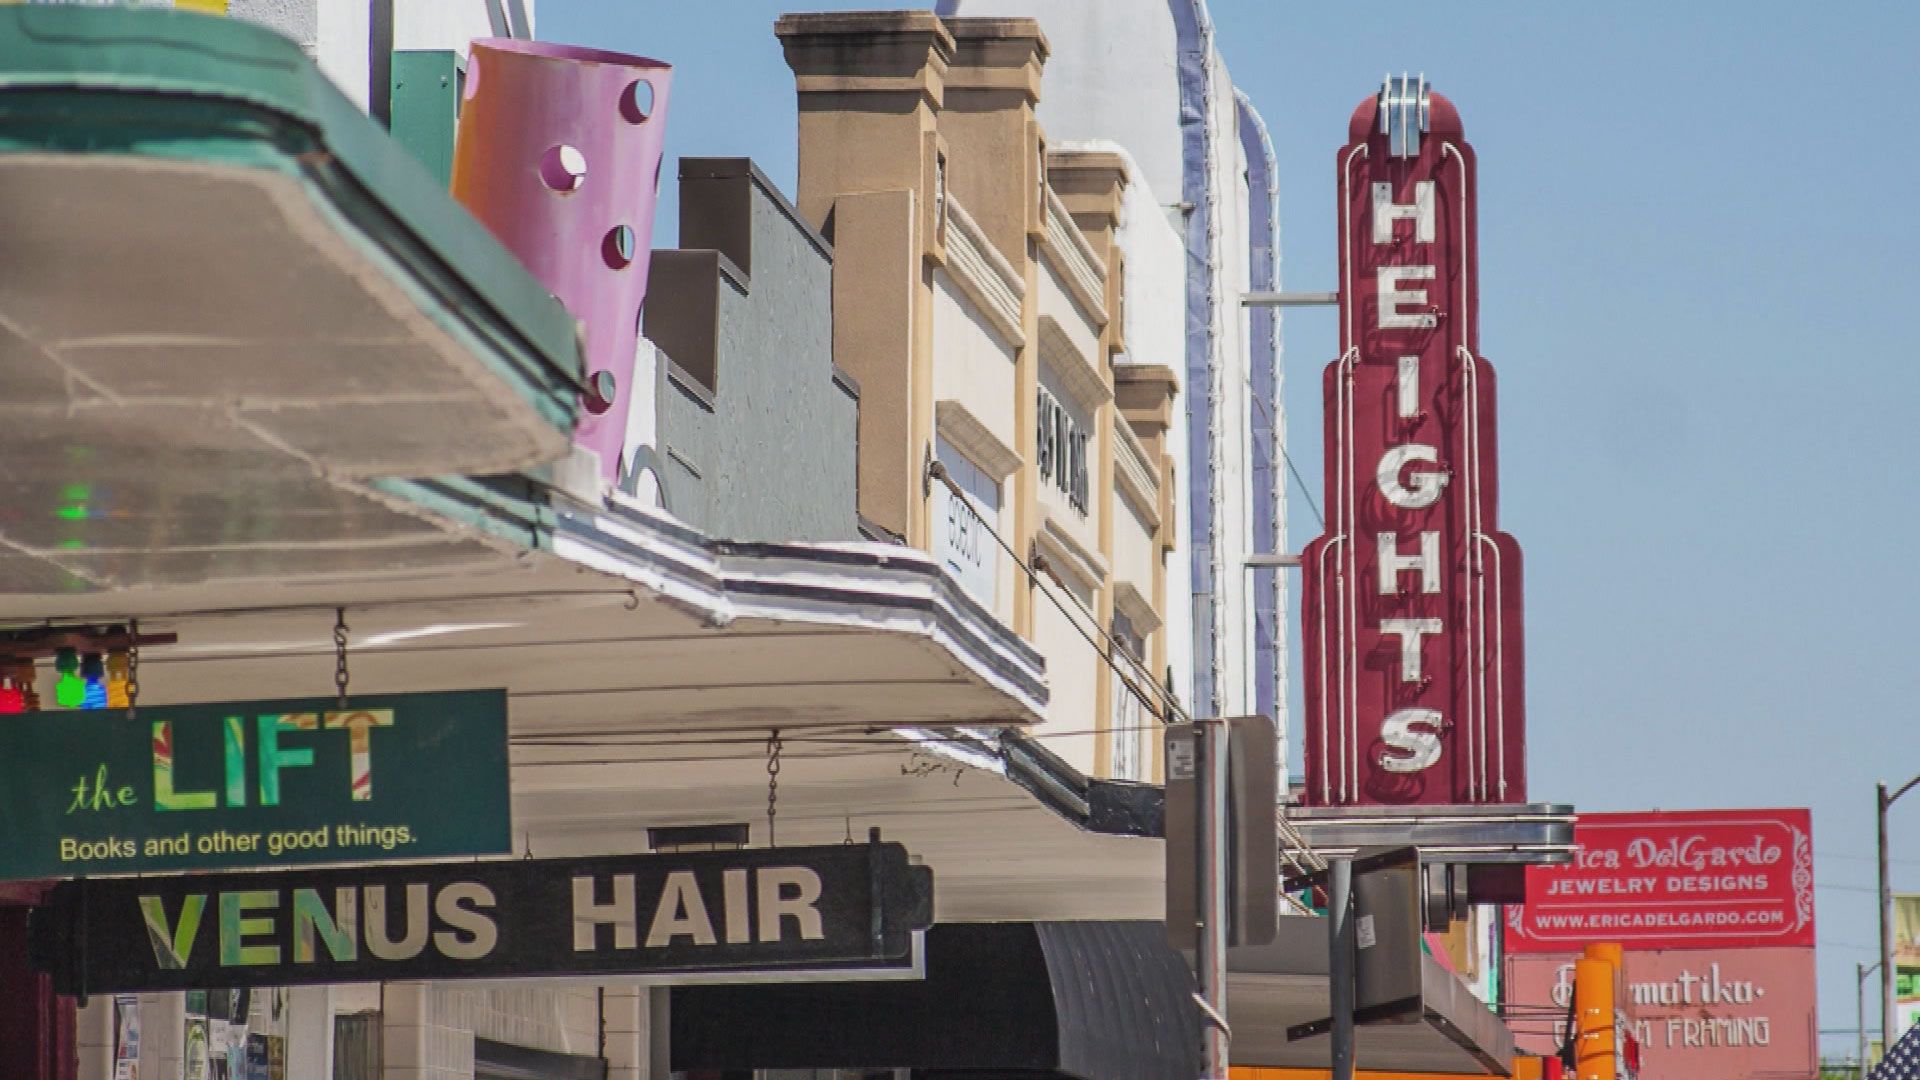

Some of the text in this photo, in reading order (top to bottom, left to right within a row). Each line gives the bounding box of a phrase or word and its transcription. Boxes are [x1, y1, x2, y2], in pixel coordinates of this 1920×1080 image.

[1372, 180, 1449, 773] HEIGHTS
[66, 708, 394, 815] the LIFT
[60, 822, 417, 862] Books and other good things.
[1547, 874, 1769, 895] JEWELRY DESIGNS
[138, 866, 824, 970] VENUS HAIR
[1536, 909, 1784, 929] WWW.ERICADELGARDO.COM
[1666, 1016, 1770, 1048] FRAMING
